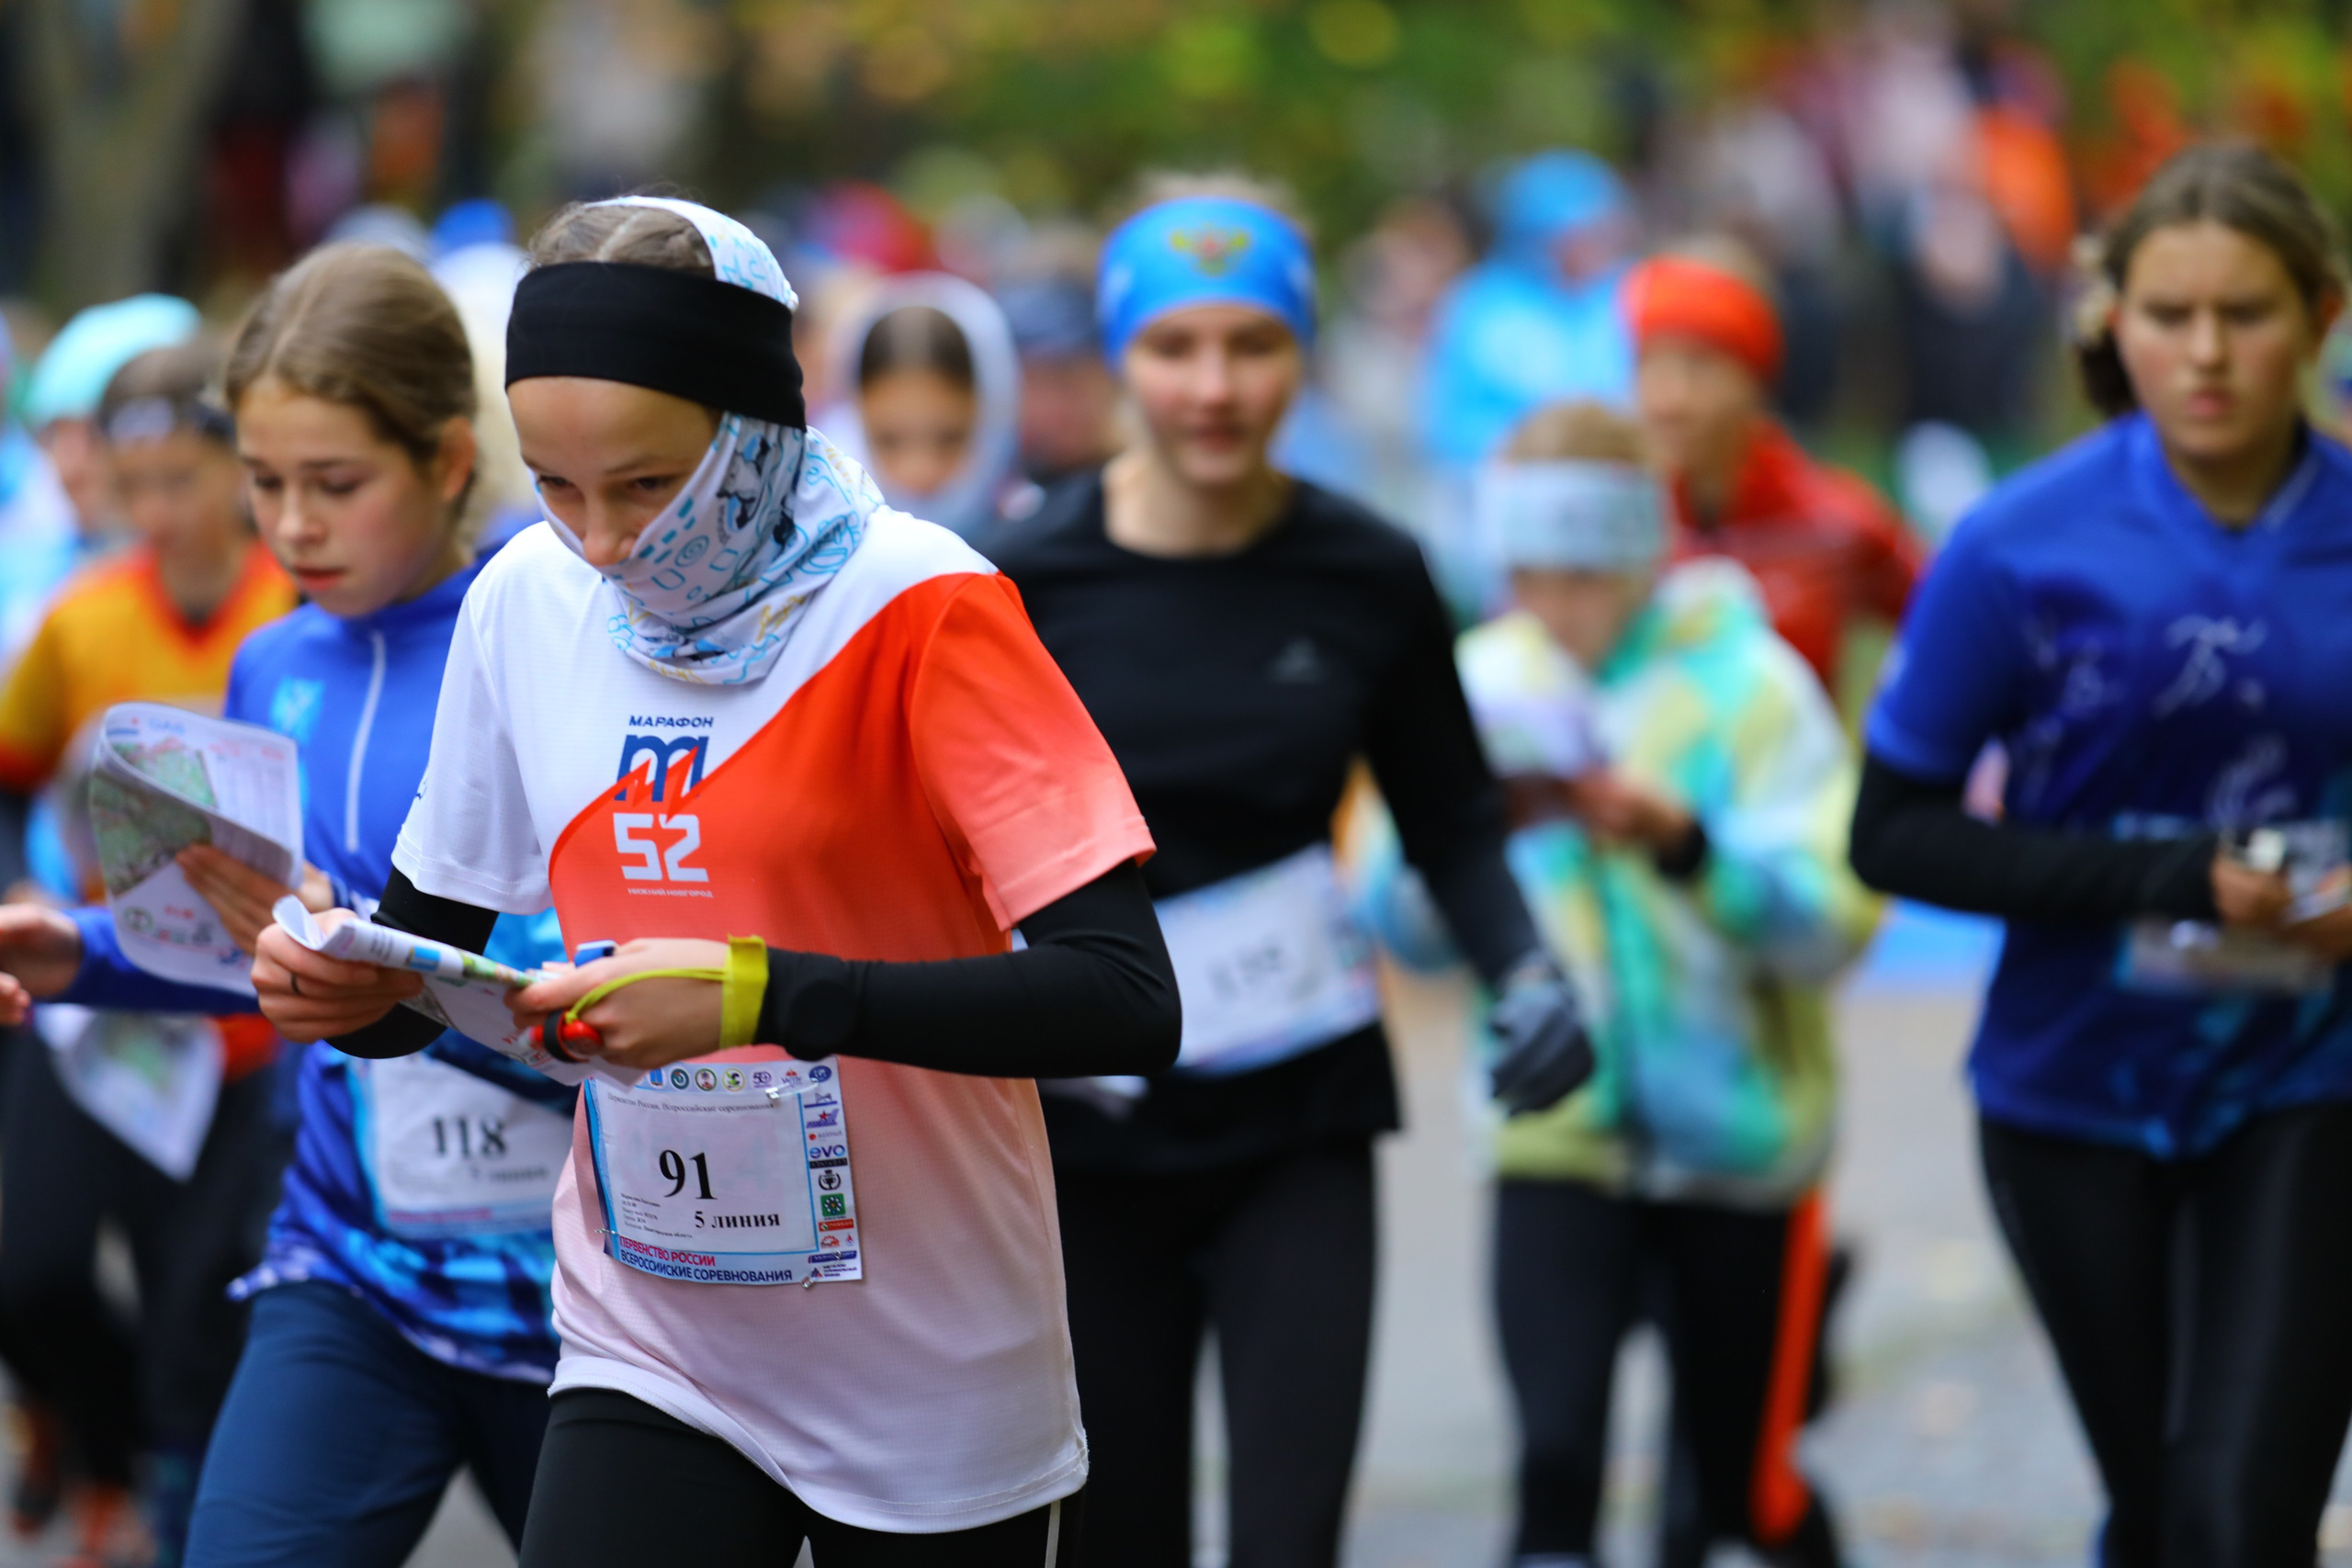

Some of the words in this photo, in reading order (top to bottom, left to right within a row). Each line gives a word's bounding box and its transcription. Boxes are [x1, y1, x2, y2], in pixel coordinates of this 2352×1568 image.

[628, 715, 714, 728] МАРАФОН
[613, 812, 709, 882] 52
[432, 1116, 508, 1159] 118
[809, 1145, 846, 1158] evo
[659, 1149, 718, 1200] 91
[694, 1210, 705, 1228] 5
[711, 1213, 780, 1229] линия
[620, 1235, 670, 1260] ПЕРВЕНСТВО
[671, 1251, 716, 1267] РОССИИ
[694, 1268, 792, 1282] СОРЕВНОВАНИЯ
